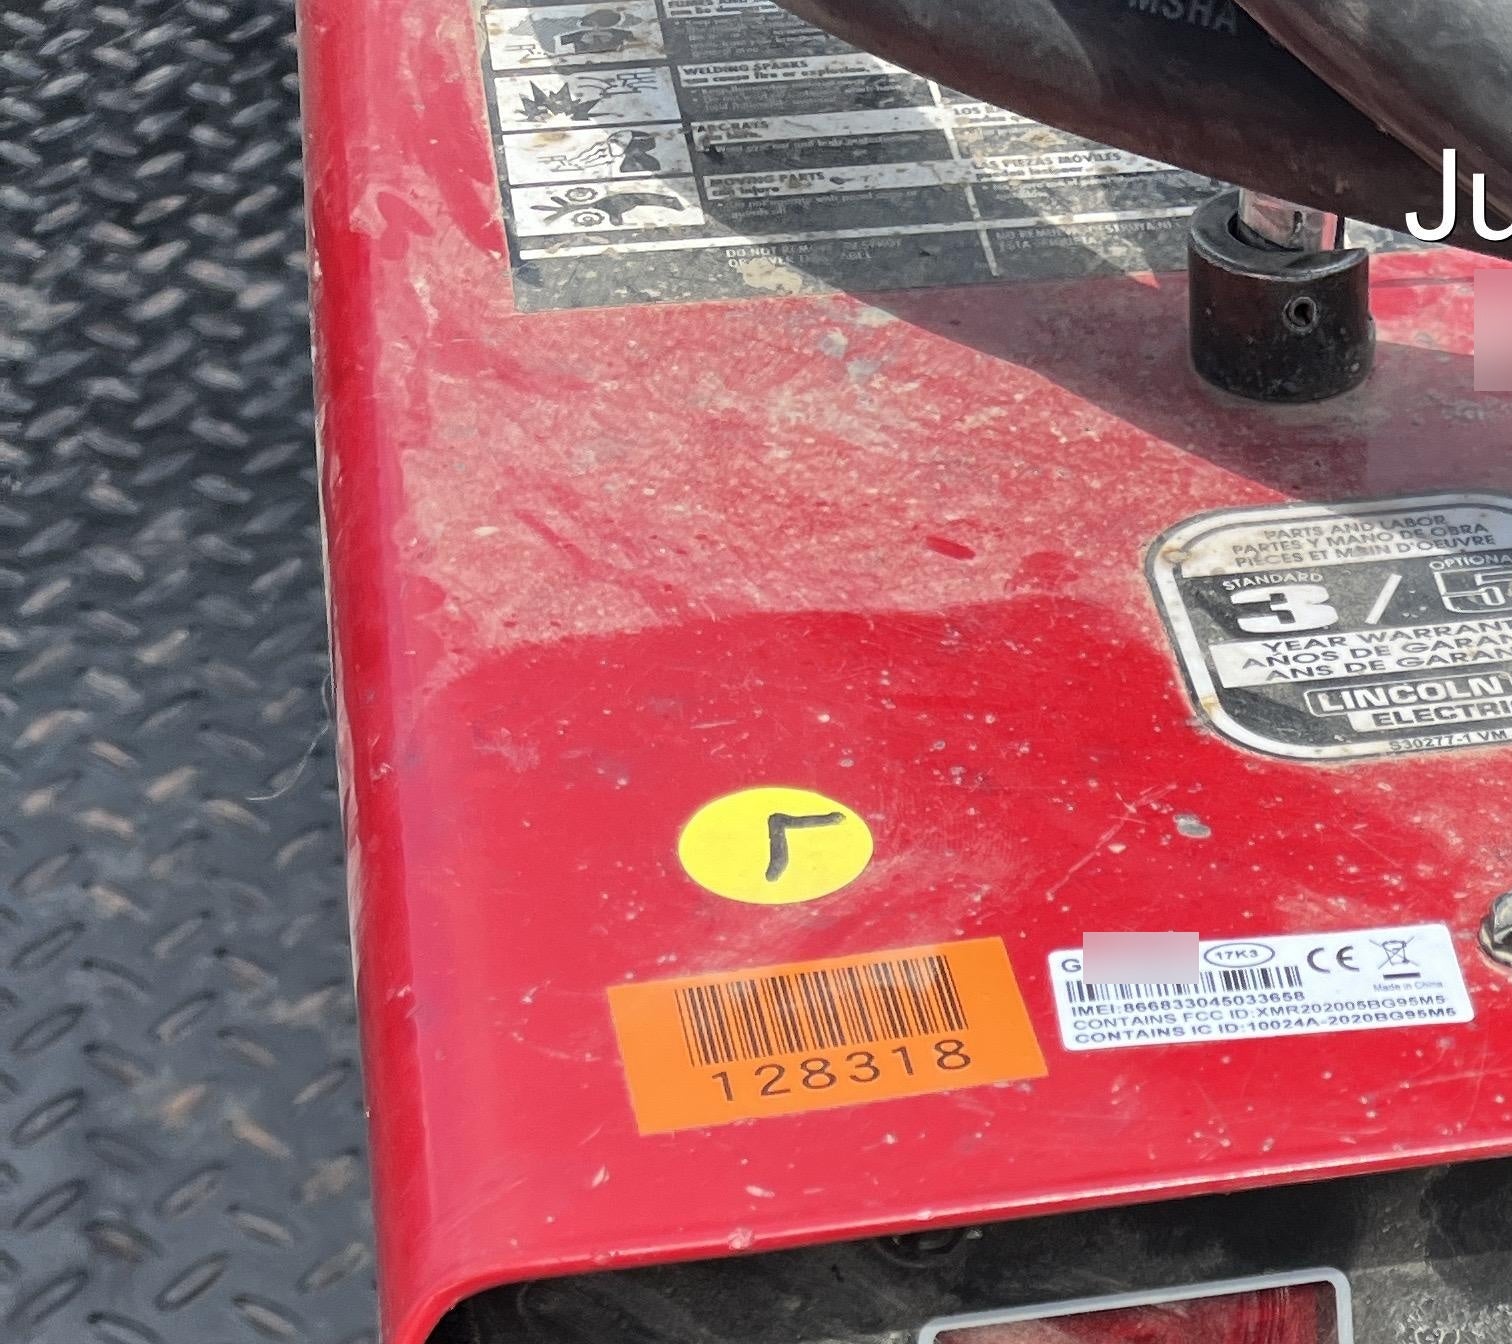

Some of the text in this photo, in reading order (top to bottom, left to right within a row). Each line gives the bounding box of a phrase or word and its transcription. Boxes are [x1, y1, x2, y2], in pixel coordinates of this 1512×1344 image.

[753, 61, 808, 72] SPARKS
[1264, 514, 1447, 541] PARTS AND LABOR
[1232, 522, 1489, 555] PARTES Y MANO DE OBRA
[1222, 572, 1324, 591] STANDARD
[1230, 584, 1339, 634] 3
[1262, 635, 1347, 653] YEAR
[1351, 644, 1390, 661] DE
[1265, 663, 1332, 681] ANS
[1344, 658, 1387, 675] DE
[1316, 675, 1506, 713] LINCOLN
[1214, 948, 1260, 961] 17K3
[1373, 982, 1401, 993] Made
[1415, 980, 1444, 990] China
[1073, 1013, 1177, 1031] CONTAINS
[1183, 1009, 1224, 1022] FCC
[1075, 1026, 1186, 1044] CONTAINS
[1191, 1024, 1213, 1036] IC
[711, 1038, 972, 1102] 128318
